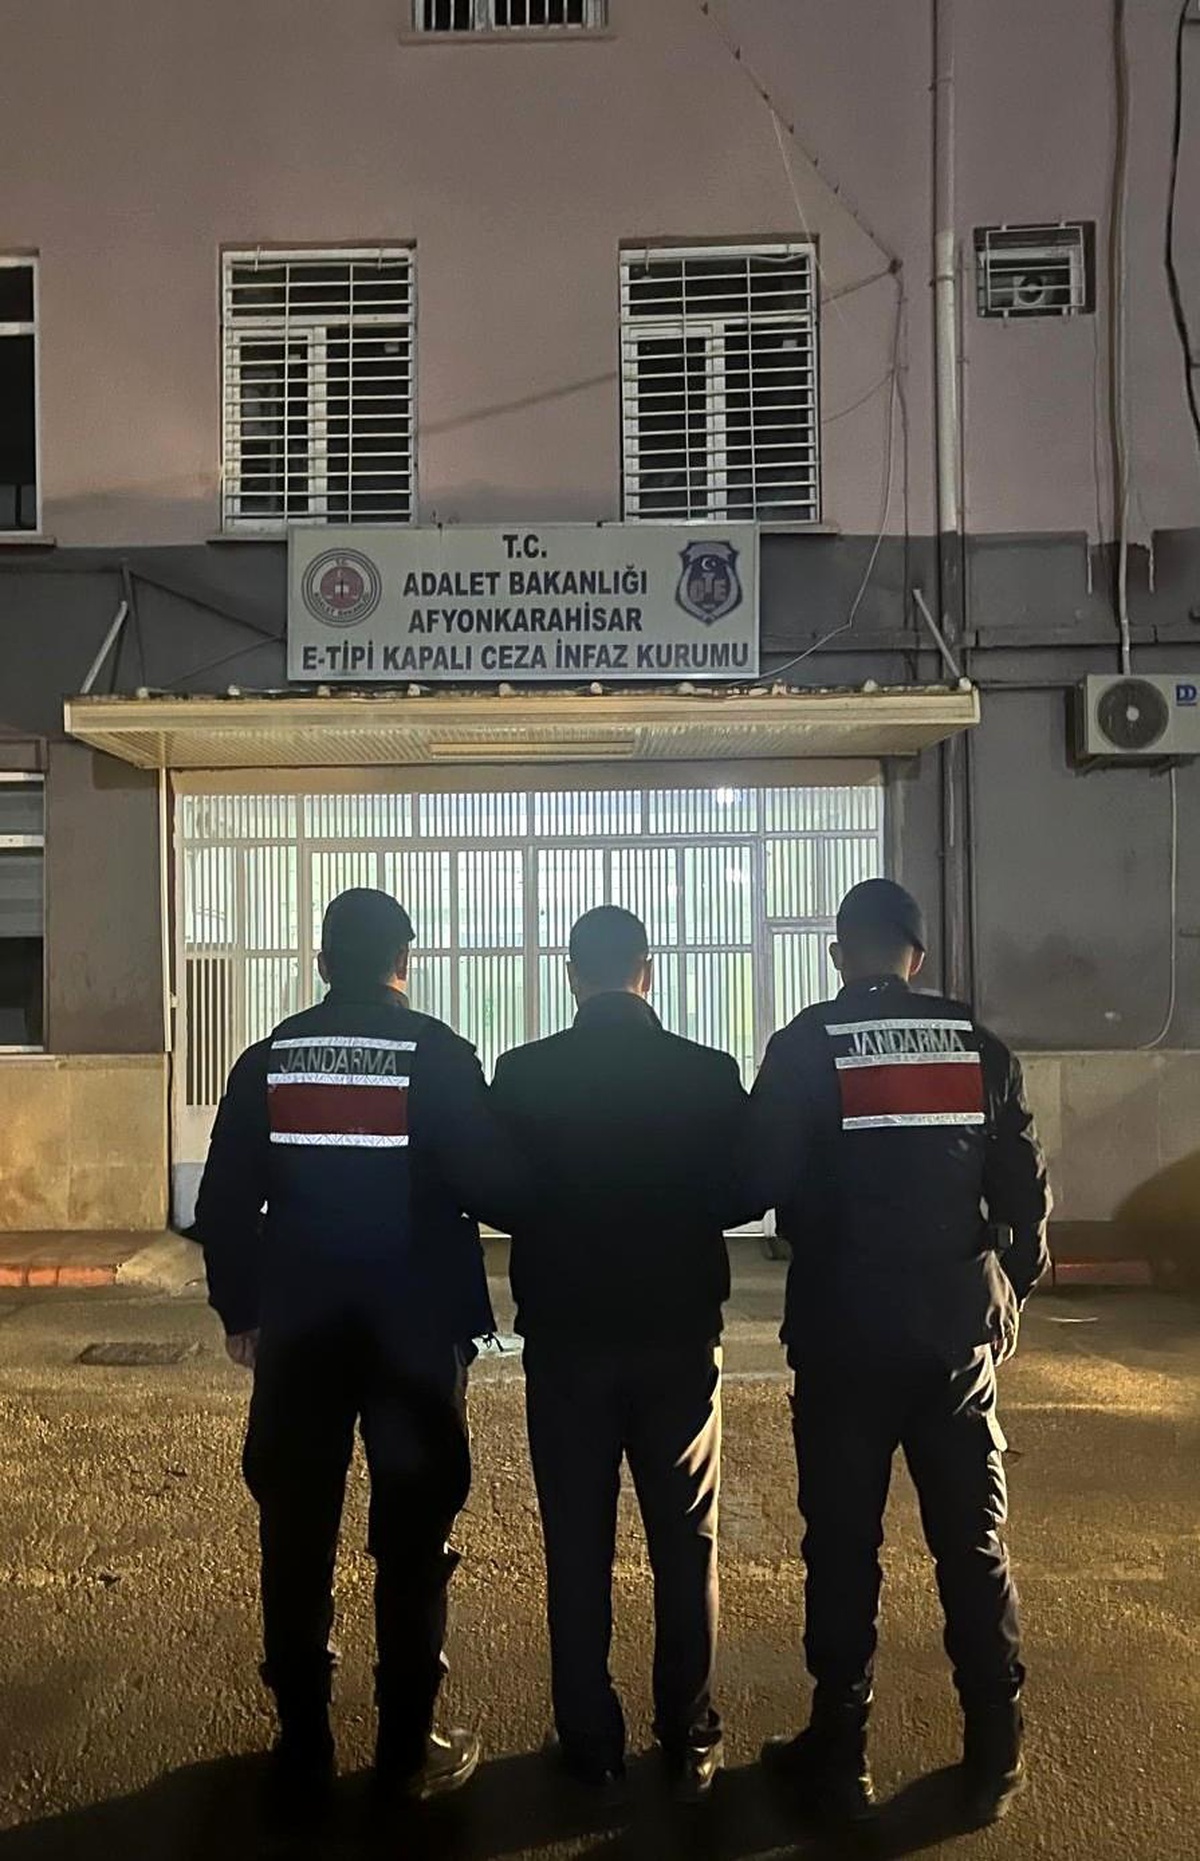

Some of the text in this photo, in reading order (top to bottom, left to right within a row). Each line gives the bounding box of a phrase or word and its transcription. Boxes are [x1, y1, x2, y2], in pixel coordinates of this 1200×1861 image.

[502, 534, 547, 559] T.C.
[403, 564, 648, 597] ADALET BAKANLIĞI
[408, 607, 642, 633] AFYONKARAHİSAR
[302, 637, 749, 672] E-TİPİ KAPALI CEZA İNFAZ KURUMU
[848, 1028, 966, 1055] JANDARMA
[280, 1047, 397, 1075] JANDARMA
